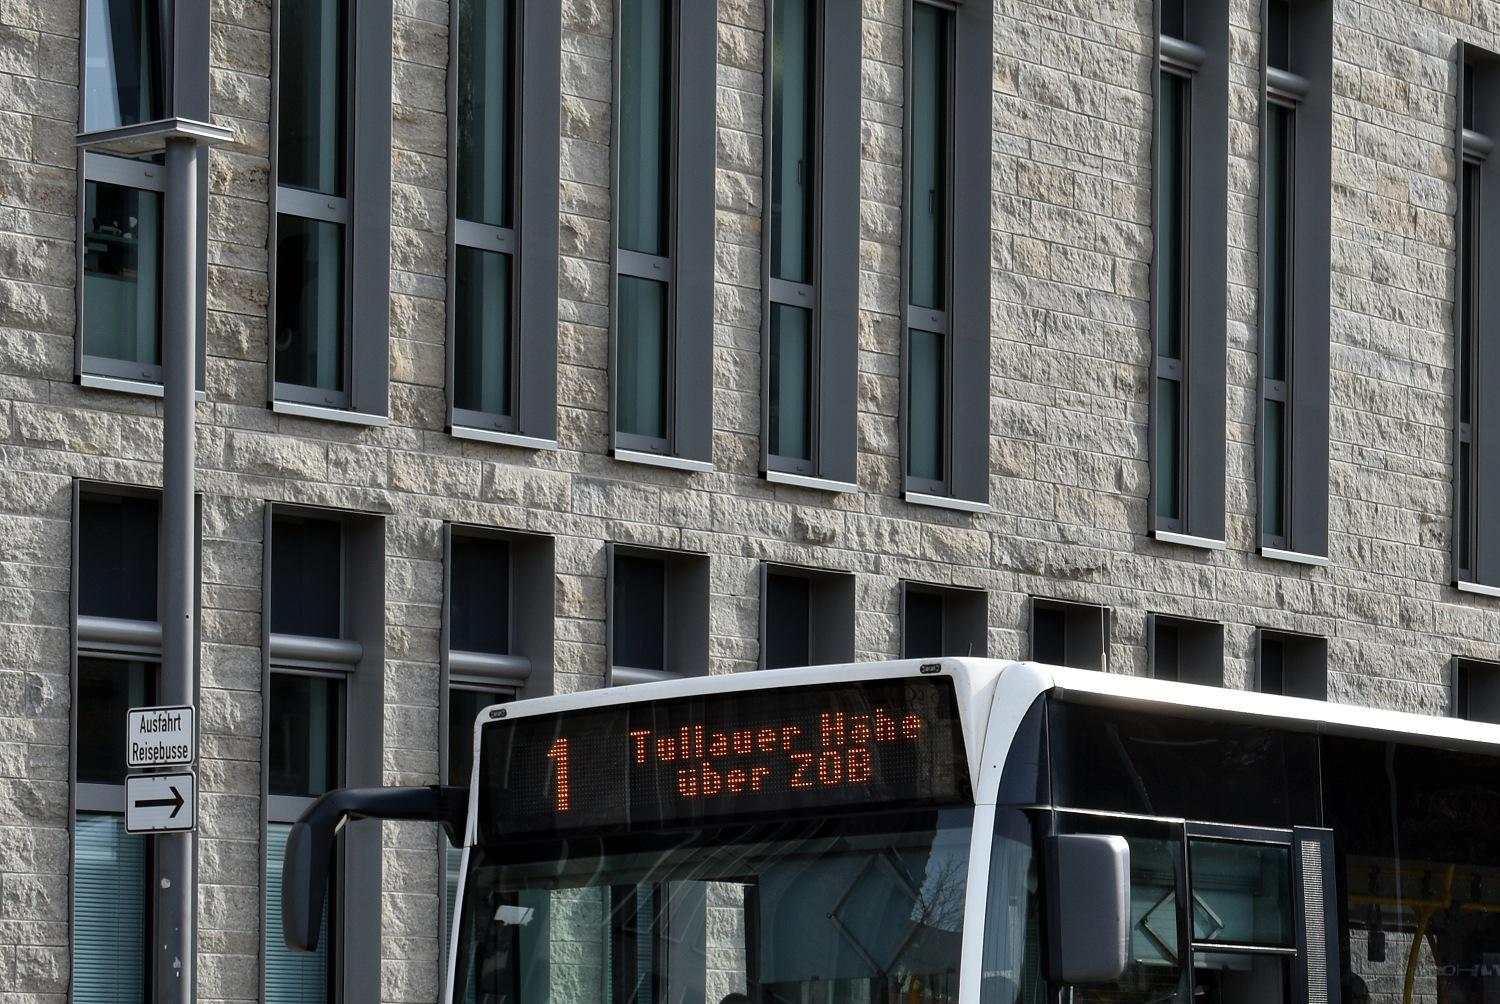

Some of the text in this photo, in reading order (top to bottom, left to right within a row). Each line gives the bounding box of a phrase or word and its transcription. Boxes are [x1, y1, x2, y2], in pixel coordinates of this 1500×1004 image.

[139, 713, 182, 733] Ausfahrt
[629, 707, 922, 764] Tullauer Höhe
[132, 741, 188, 762] Reisebusse
[546, 736, 570, 814] 1
[678, 747, 871, 797] über ZOB
